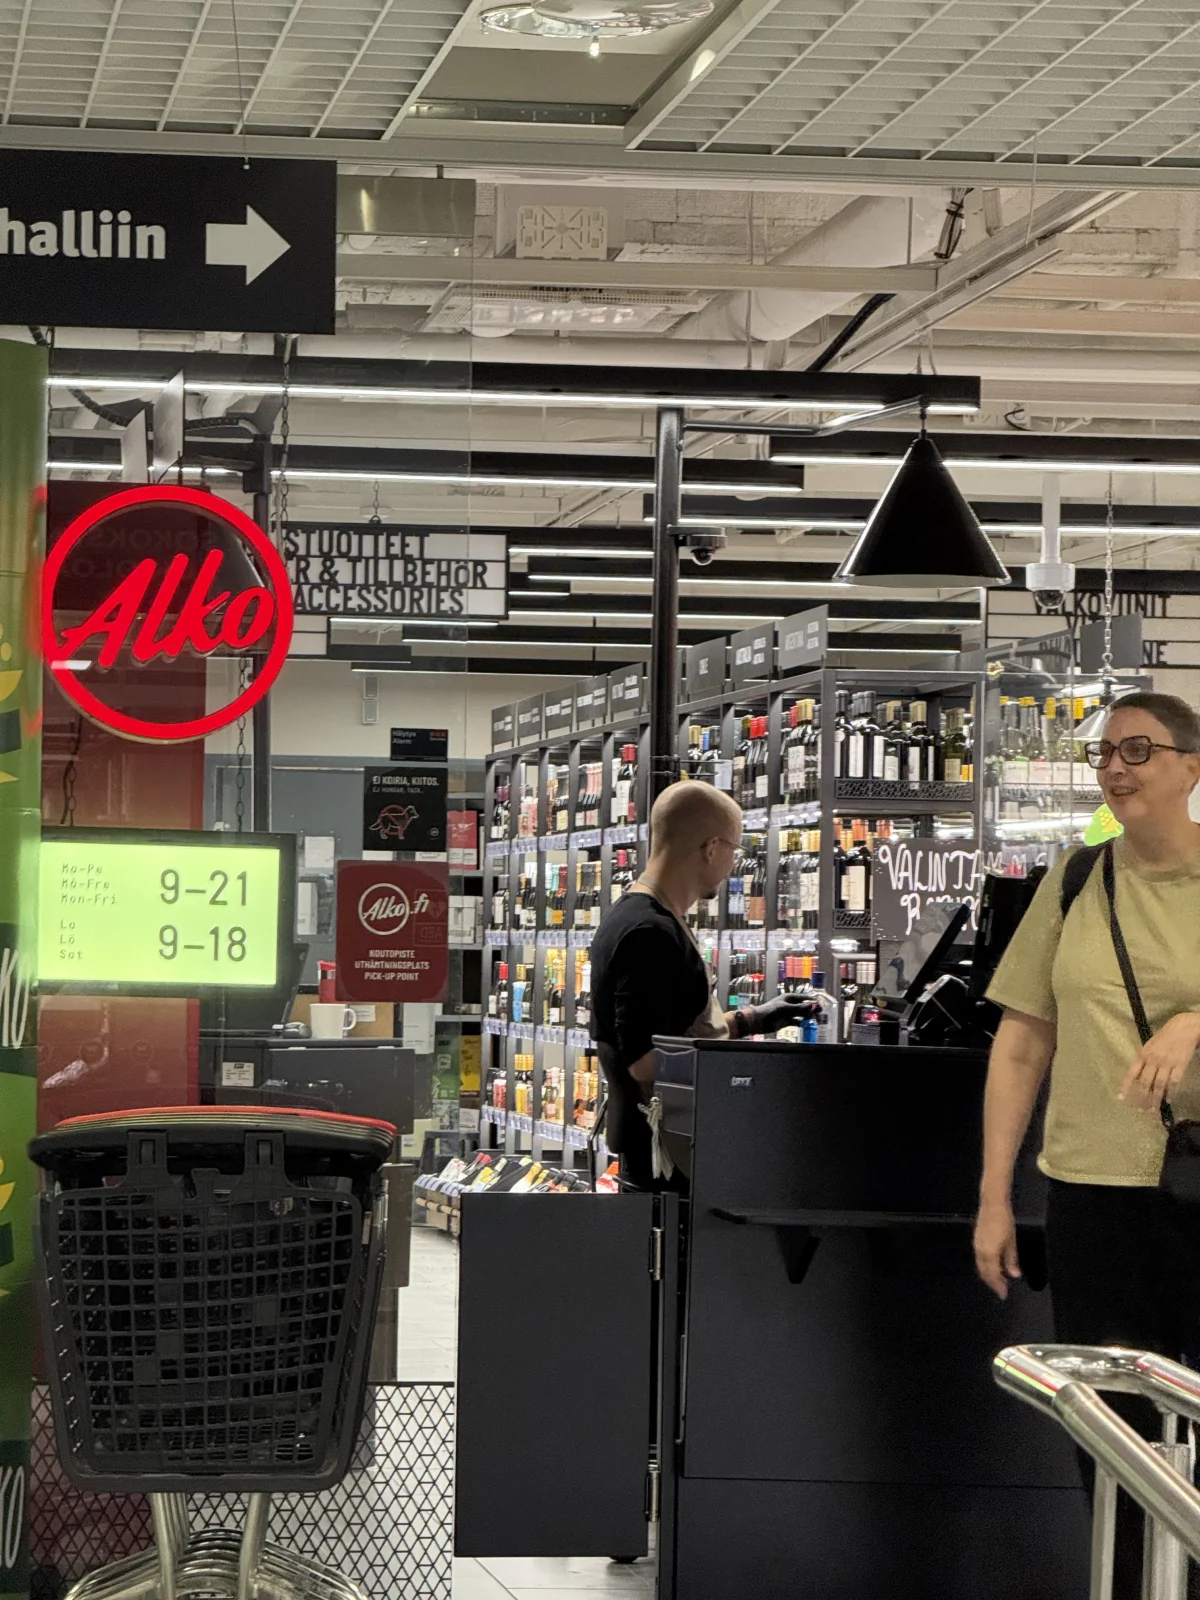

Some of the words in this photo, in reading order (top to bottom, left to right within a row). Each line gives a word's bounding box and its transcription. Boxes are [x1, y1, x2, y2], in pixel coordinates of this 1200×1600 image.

[0, 207, 166, 260] halliin
[284, 529, 431, 559] STUOTTEET
[319, 557, 340, 586] &
[347, 557, 488, 588] TILLBEHÖR
[59, 549, 275, 668] Alko
[293, 585, 464, 614] ACCESSORIES
[412, 776, 440, 786] KIITOS.
[160, 868, 248, 906] 9-21
[159, 924, 247, 962] 9-18
[368, 949, 416, 958] NOUTOPISTE
[364, 972, 396, 981] PICK-UP
[396, 972, 420, 981] POINT
